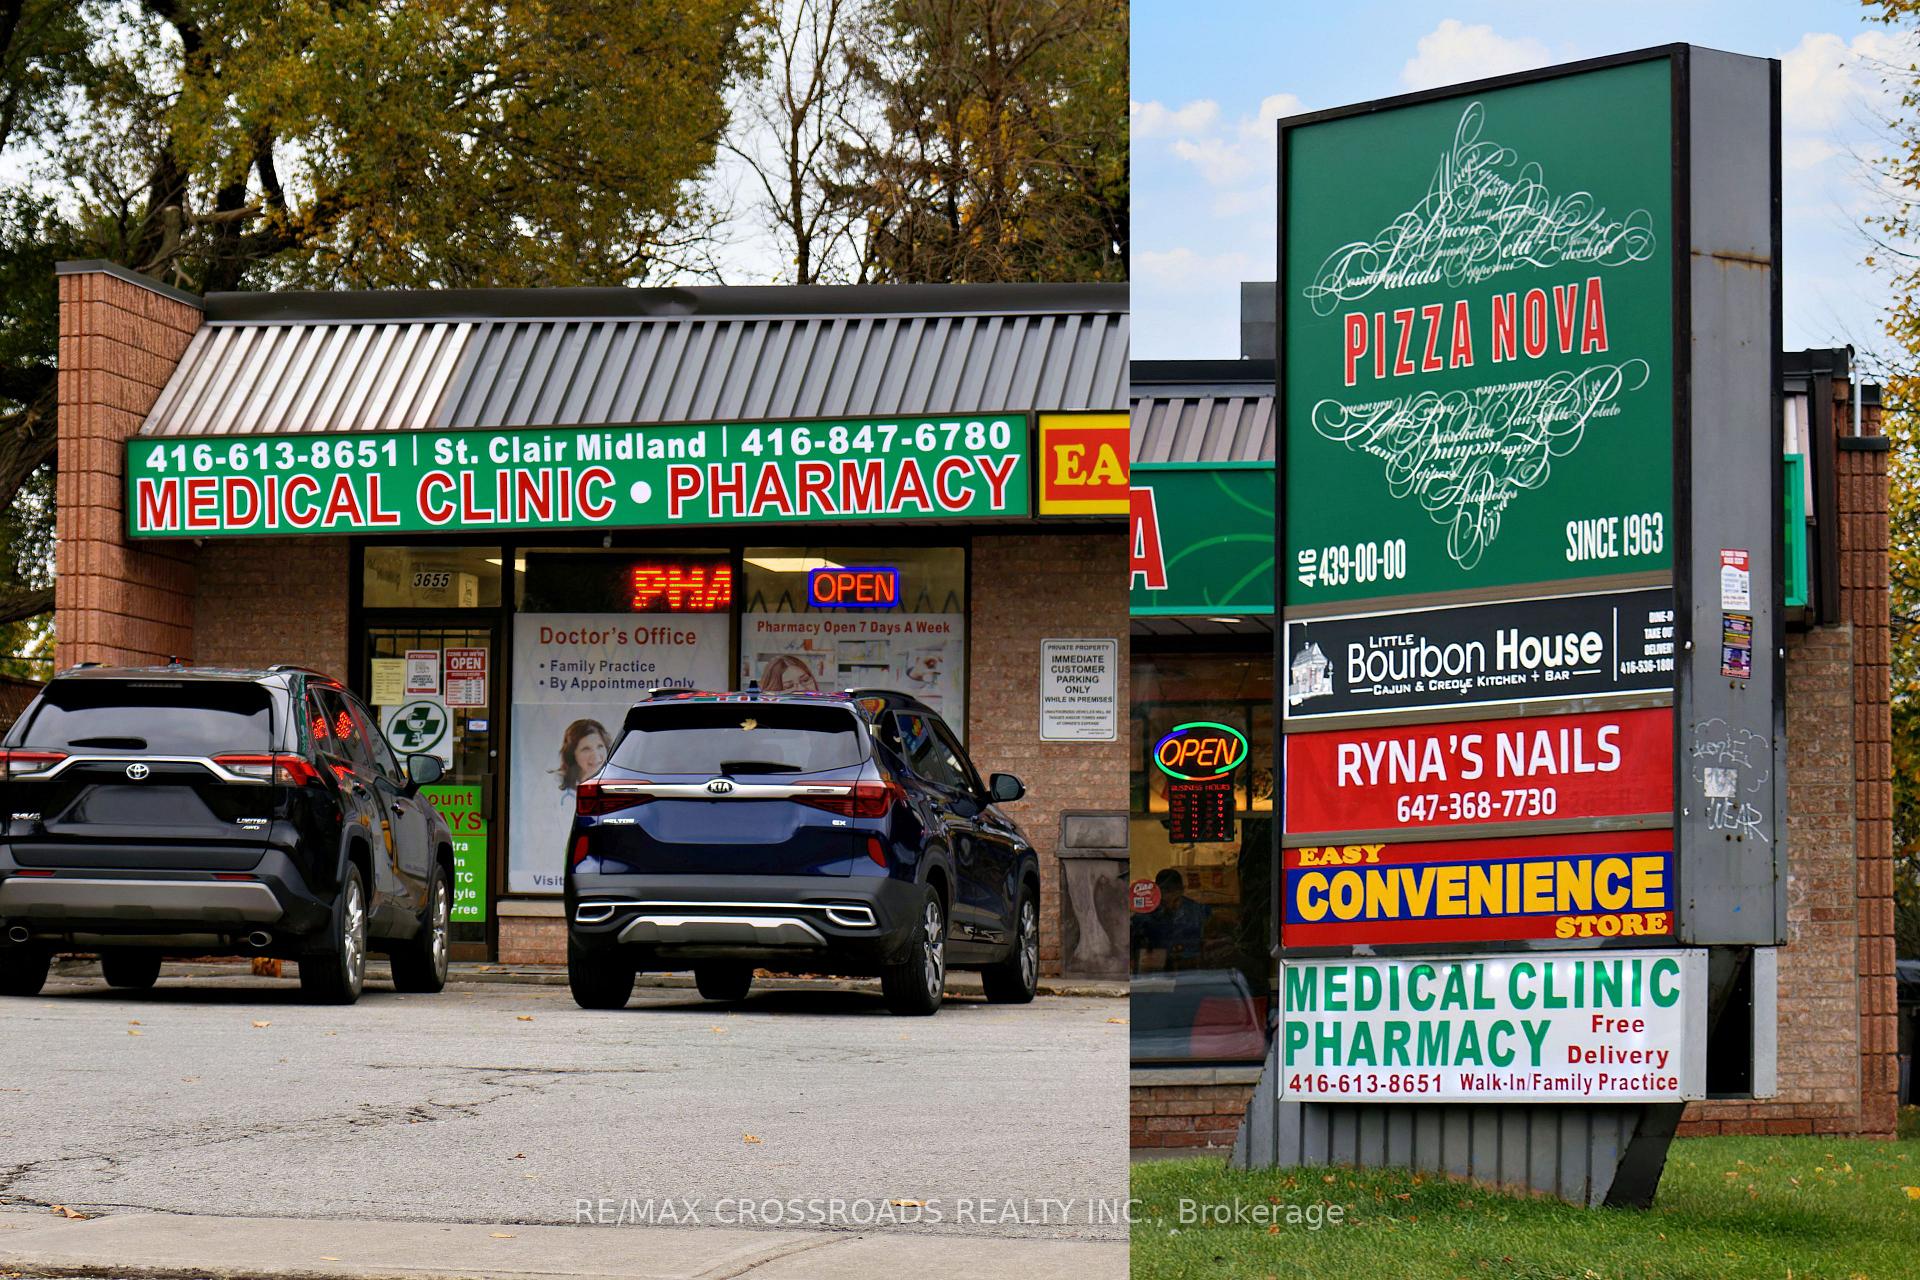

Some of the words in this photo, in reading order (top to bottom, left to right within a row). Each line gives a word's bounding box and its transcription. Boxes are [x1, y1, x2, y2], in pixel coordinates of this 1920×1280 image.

[1344, 300, 1474, 387] PIZZA
[1491, 276, 1609, 363] NOVA
[146, 438, 398, 473] 416-613-8651
[434, 437, 478, 466] St.
[488, 432, 567, 463] Clair
[576, 430, 706, 462] Midland
[741, 420, 1012, 458] 416-847-6780
[1053, 443, 1129, 487] EA
[136, 472, 401, 532] MEDICAL
[416, 464, 616, 527] CLINIC
[667, 453, 1020, 519] PHARMACY
[1566, 517, 1618, 563] SINCE
[1623, 511, 1664, 556] 1963
[1298, 548, 1317, 588] 416
[1318, 539, 1406, 587] 439-00-00
[413, 572, 451, 588] 3655
[814, 572, 896, 602] OPEN
[539, 626, 628, 646] Doctor's
[635, 626, 697, 646] Office
[757, 621, 820, 636] Pharmacy
[824, 621, 857, 636] Open
[859, 621, 868, 634] 7
[870, 621, 901, 636] Days
[904, 621, 914, 634] A
[916, 621, 950, 634] Week
[1369, 633, 1415, 649] LITTLE
[450, 657, 482, 670] OPEN
[550, 659, 595, 675] Family
[600, 659, 656, 673] Practice
[1051, 655, 1105, 664] IMMEDIATE
[1347, 636, 1495, 684] Bourbon
[1496, 628, 1604, 670] House
[1051, 665, 1105, 674] CUSTOMER
[1056, 675, 1099, 684] PARKING
[550, 677, 568, 690] By
[572, 676, 660, 690] Appointment
[663, 676, 695, 689] Only
[1065, 685, 1091, 694] ONLY
[1372, 682, 1412, 697] CAJUN
[1415, 680, 1425, 693] &
[1476, 674, 1527, 688] KITCHEN
[1545, 670, 1570, 682] BAR
[1159, 737, 1239, 767] OPEN
[1337, 734, 1484, 788] RYNA'S
[1495, 724, 1622, 778] NAILS
[428, 791, 473, 806] ount
[709, 781, 731, 794] KIA
[1396, 786, 1557, 823] 647-368-7730
[1298, 843, 1386, 867] EASY
[456, 872, 474, 883] TC
[1296, 856, 1665, 922] CONVENIENCE
[1555, 912, 1669, 939] STORE
[1285, 964, 1496, 1013] MEDICAL
[1508, 957, 1681, 1010] CLINIC
[1285, 1018, 1552, 1068] PHARMACY
[1591, 1014, 1646, 1033] Free
[1567, 1045, 1669, 1069] Delivery
[1289, 1073, 1443, 1094] 416-613-8651
[1599, 1072, 1679, 1092] Practice
